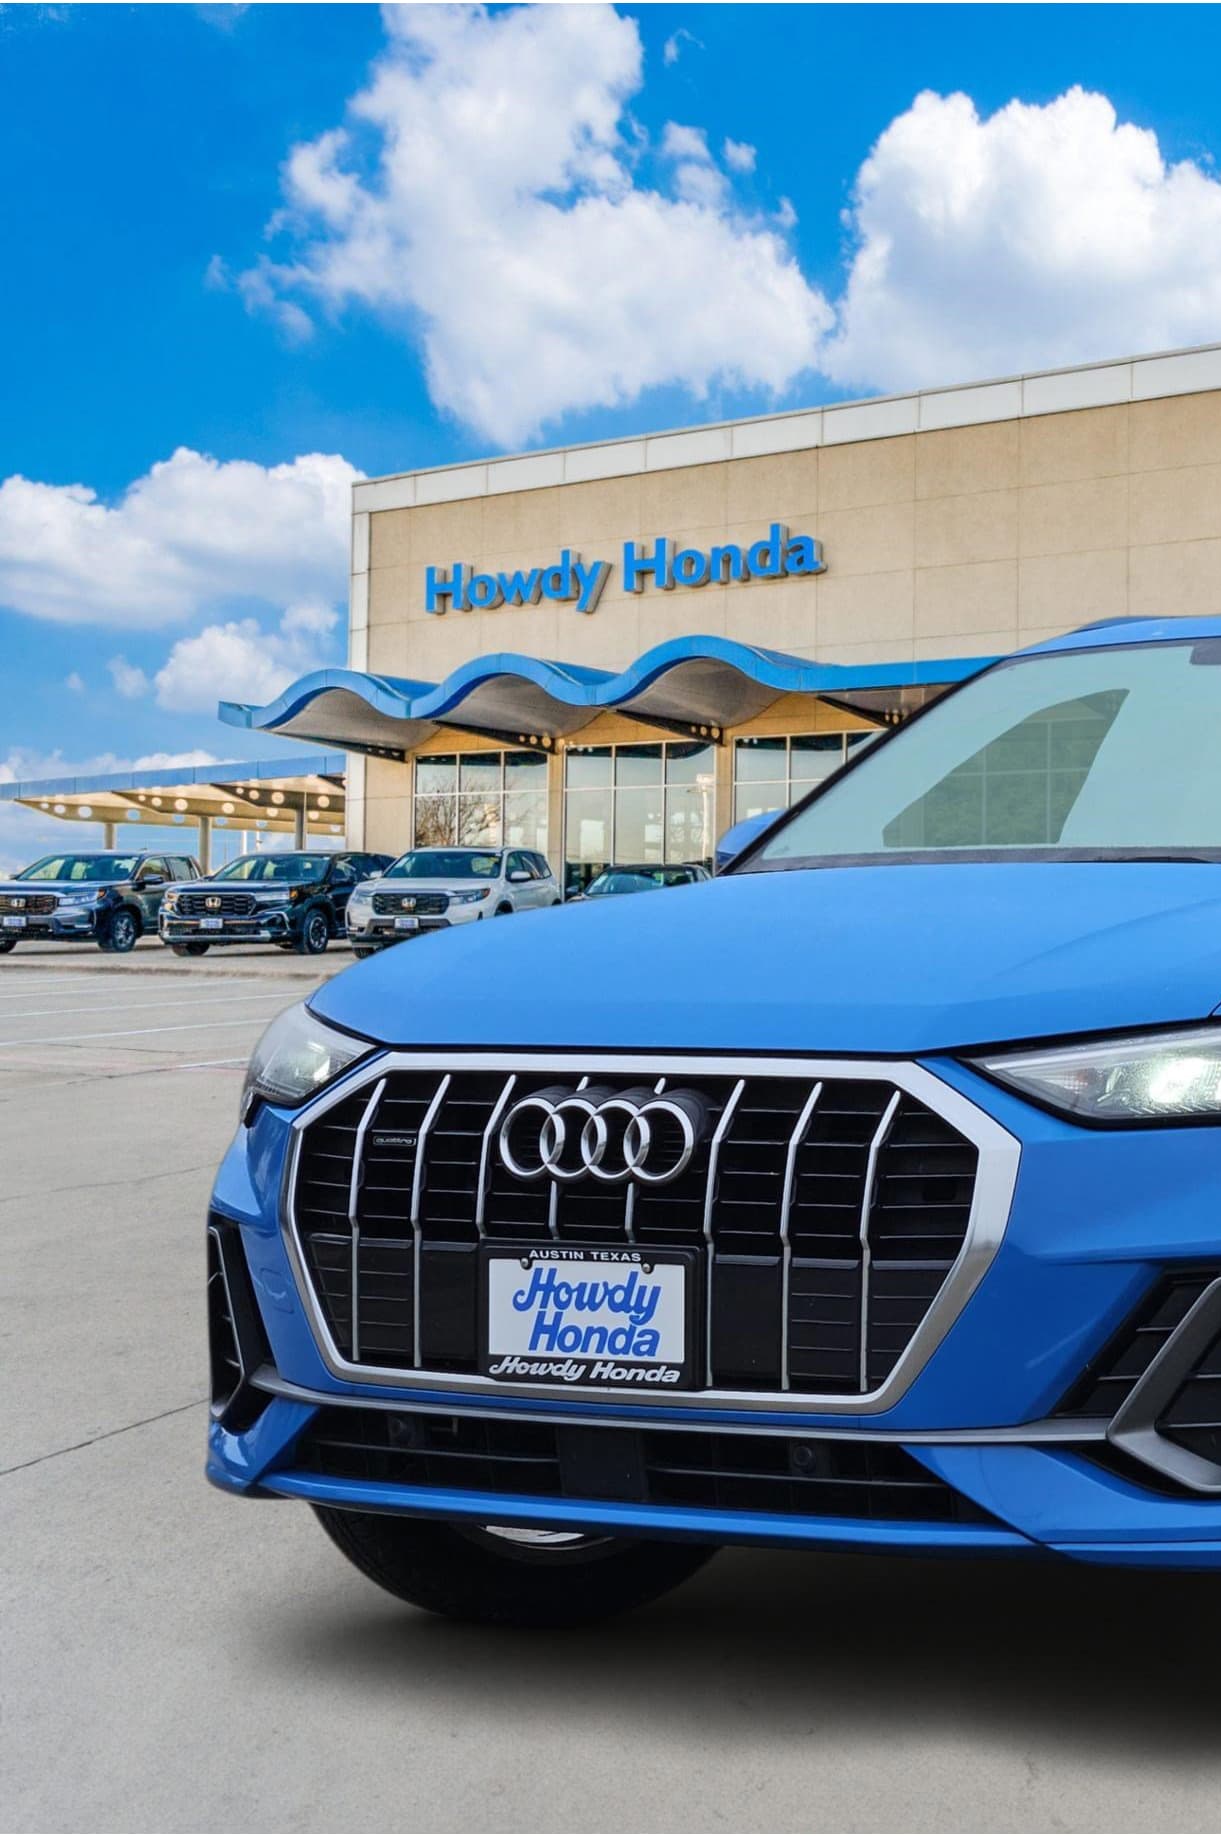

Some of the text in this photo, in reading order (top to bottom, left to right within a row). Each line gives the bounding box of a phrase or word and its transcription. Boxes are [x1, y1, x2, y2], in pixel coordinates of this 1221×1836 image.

[425, 522, 827, 615] Howdy Honda
[528, 1249, 642, 1263] AUSTIN TEXAS
[512, 1267, 662, 1326] Howdy
[528, 1310, 661, 1357] Honda
[488, 1355, 681, 1384] Howdy Honda
